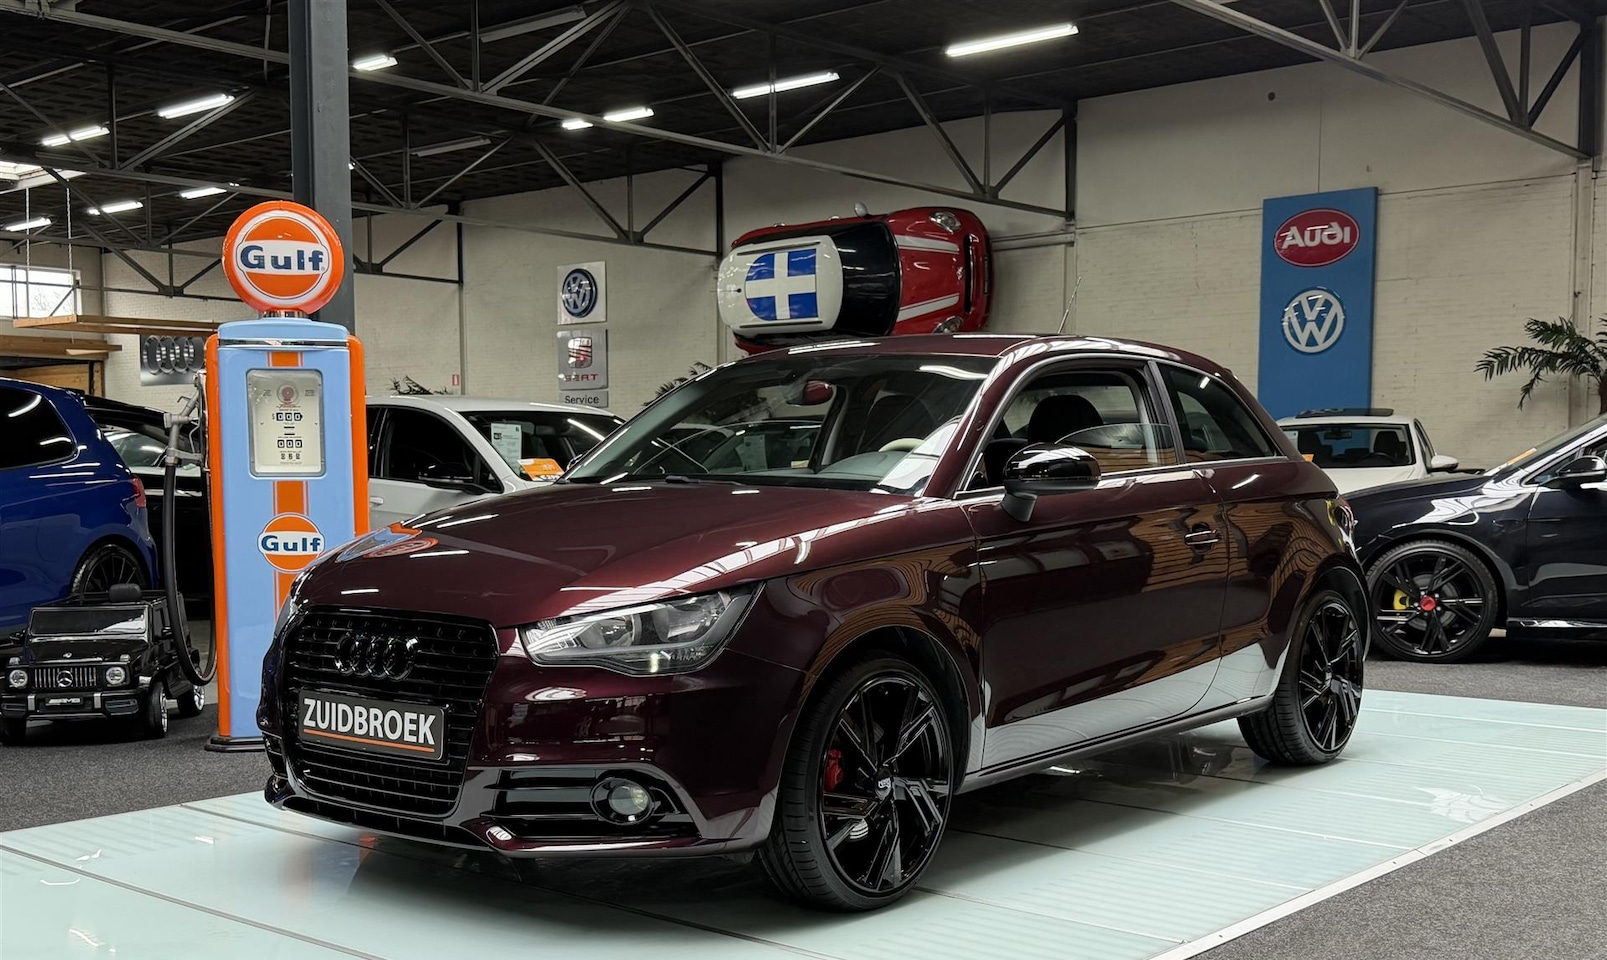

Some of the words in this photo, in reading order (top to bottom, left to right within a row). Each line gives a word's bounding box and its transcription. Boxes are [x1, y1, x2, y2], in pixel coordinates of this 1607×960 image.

[240, 244, 324, 271] Gulf
[564, 395, 599, 405] Service
[261, 534, 321, 552] Gulf
[303, 698, 436, 745] ZUIDBROEK
